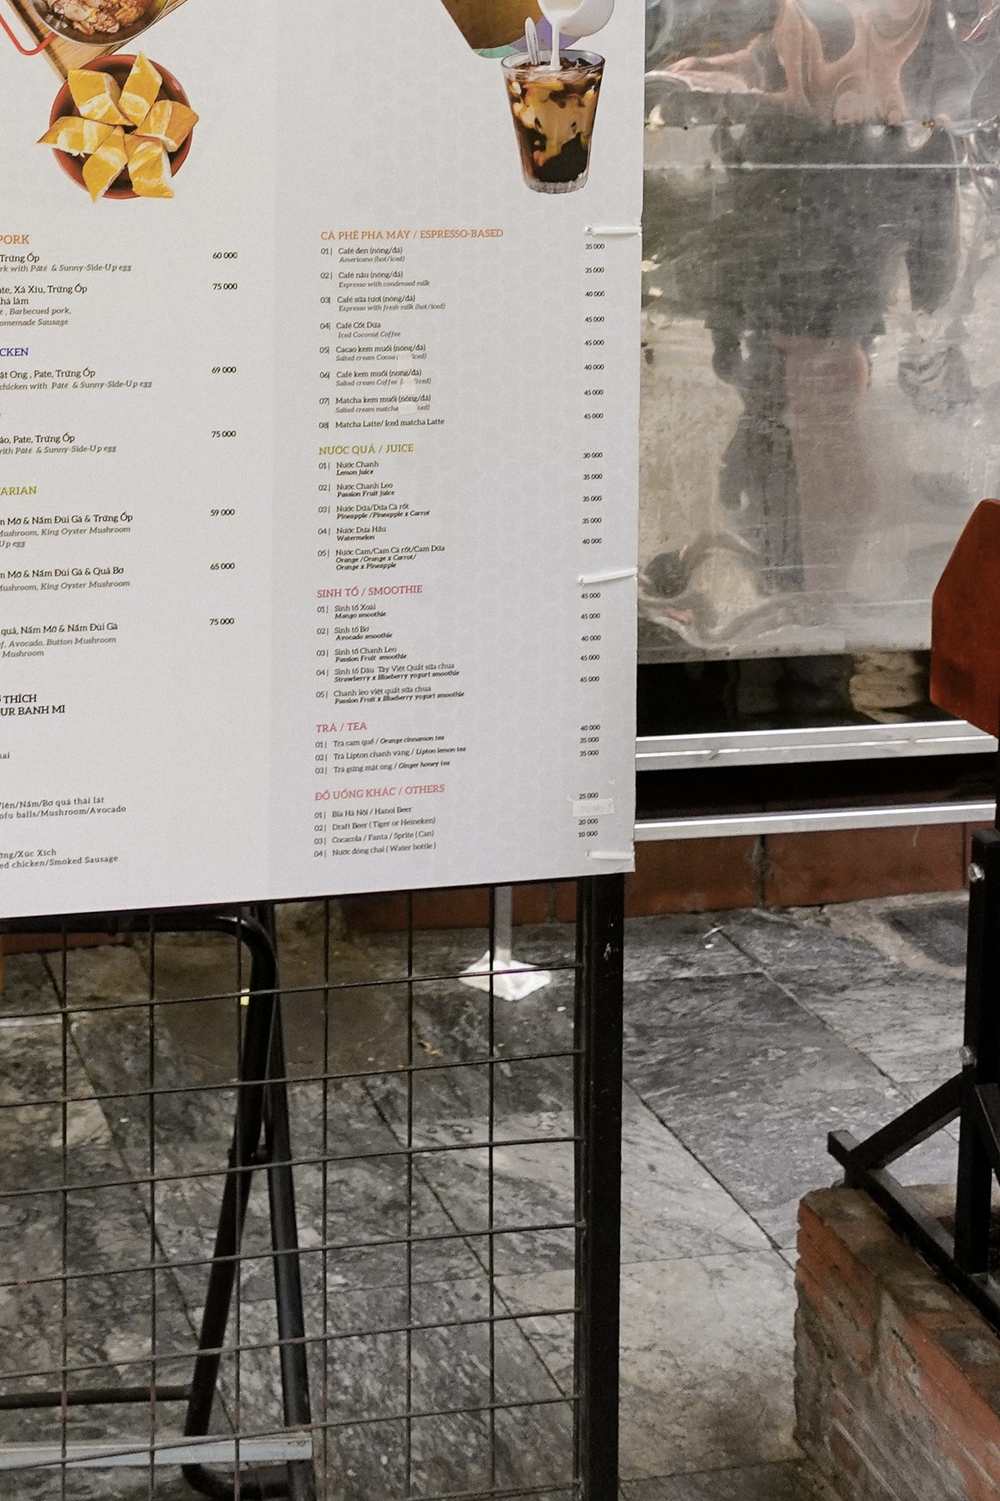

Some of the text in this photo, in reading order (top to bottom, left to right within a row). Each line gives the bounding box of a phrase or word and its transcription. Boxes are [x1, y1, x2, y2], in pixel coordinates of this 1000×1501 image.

[420, 229, 503, 239] ESPRESSO-BASED
[38, 318, 68, 327] Sausage
[386, 443, 413, 453] JUICE
[41, 528, 59, 536] King
[61, 528, 87, 536] Oyster
[89, 526, 131, 534] Mushroom
[317, 589, 342, 598] SINH
[368, 584, 422, 596] SMOOTHIE
[18, 706, 49, 715] BANH
[52, 705, 65, 713] MI
[347, 722, 367, 731] TEA
[405, 784, 445, 795] OTHERS
